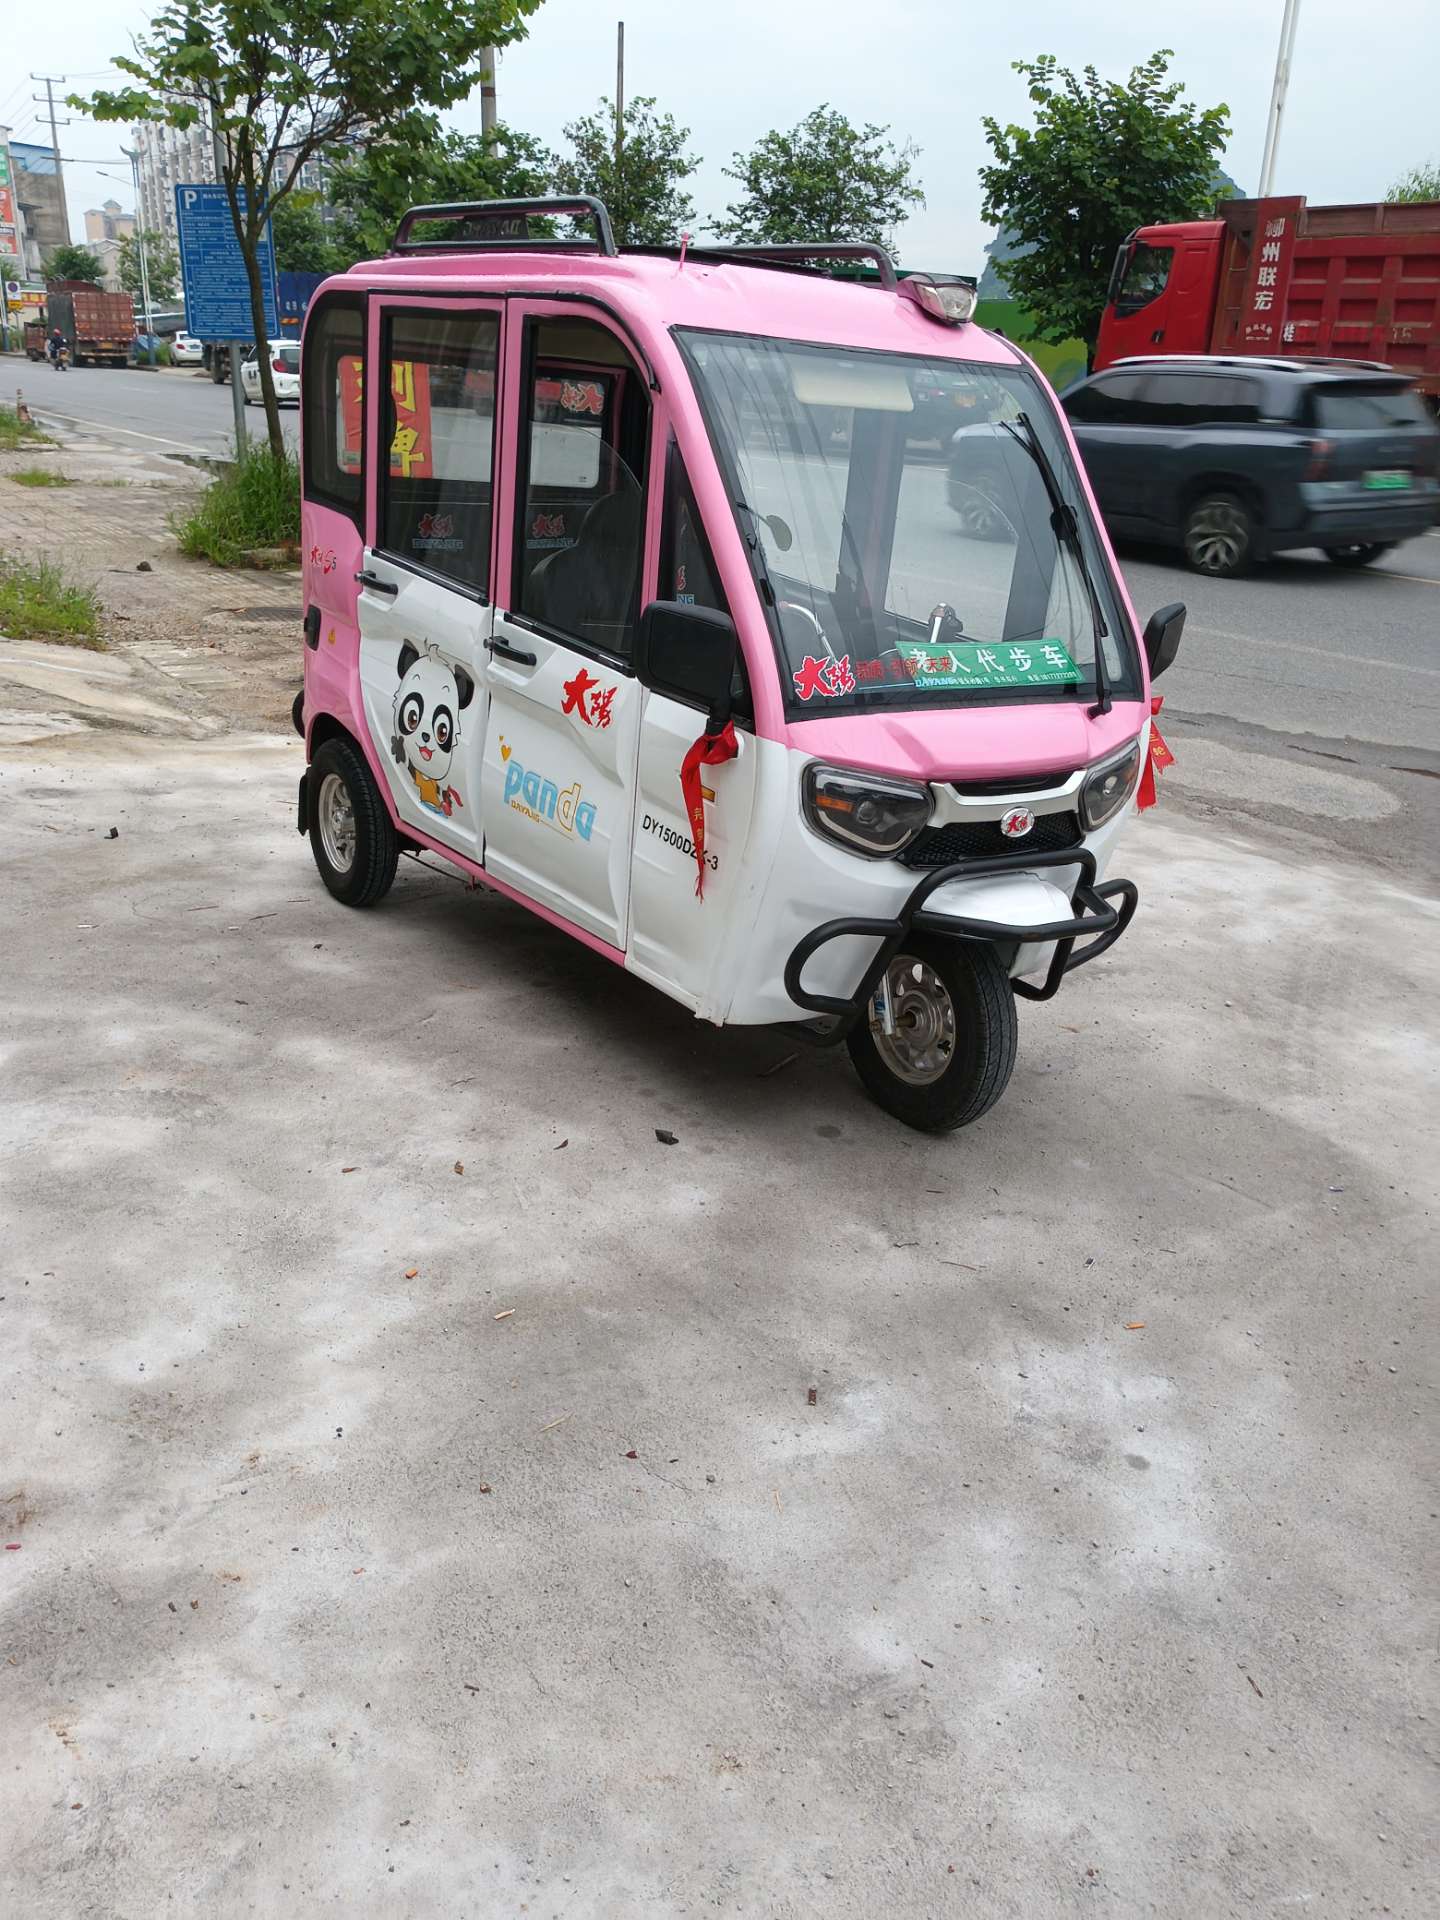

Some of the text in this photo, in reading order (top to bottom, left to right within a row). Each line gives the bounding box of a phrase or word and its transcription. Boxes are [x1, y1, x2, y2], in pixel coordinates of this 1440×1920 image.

[184, 190, 197, 209] P
[910, 645, 1069, 674] 老人代步车
[504, 760, 597, 842] panda
